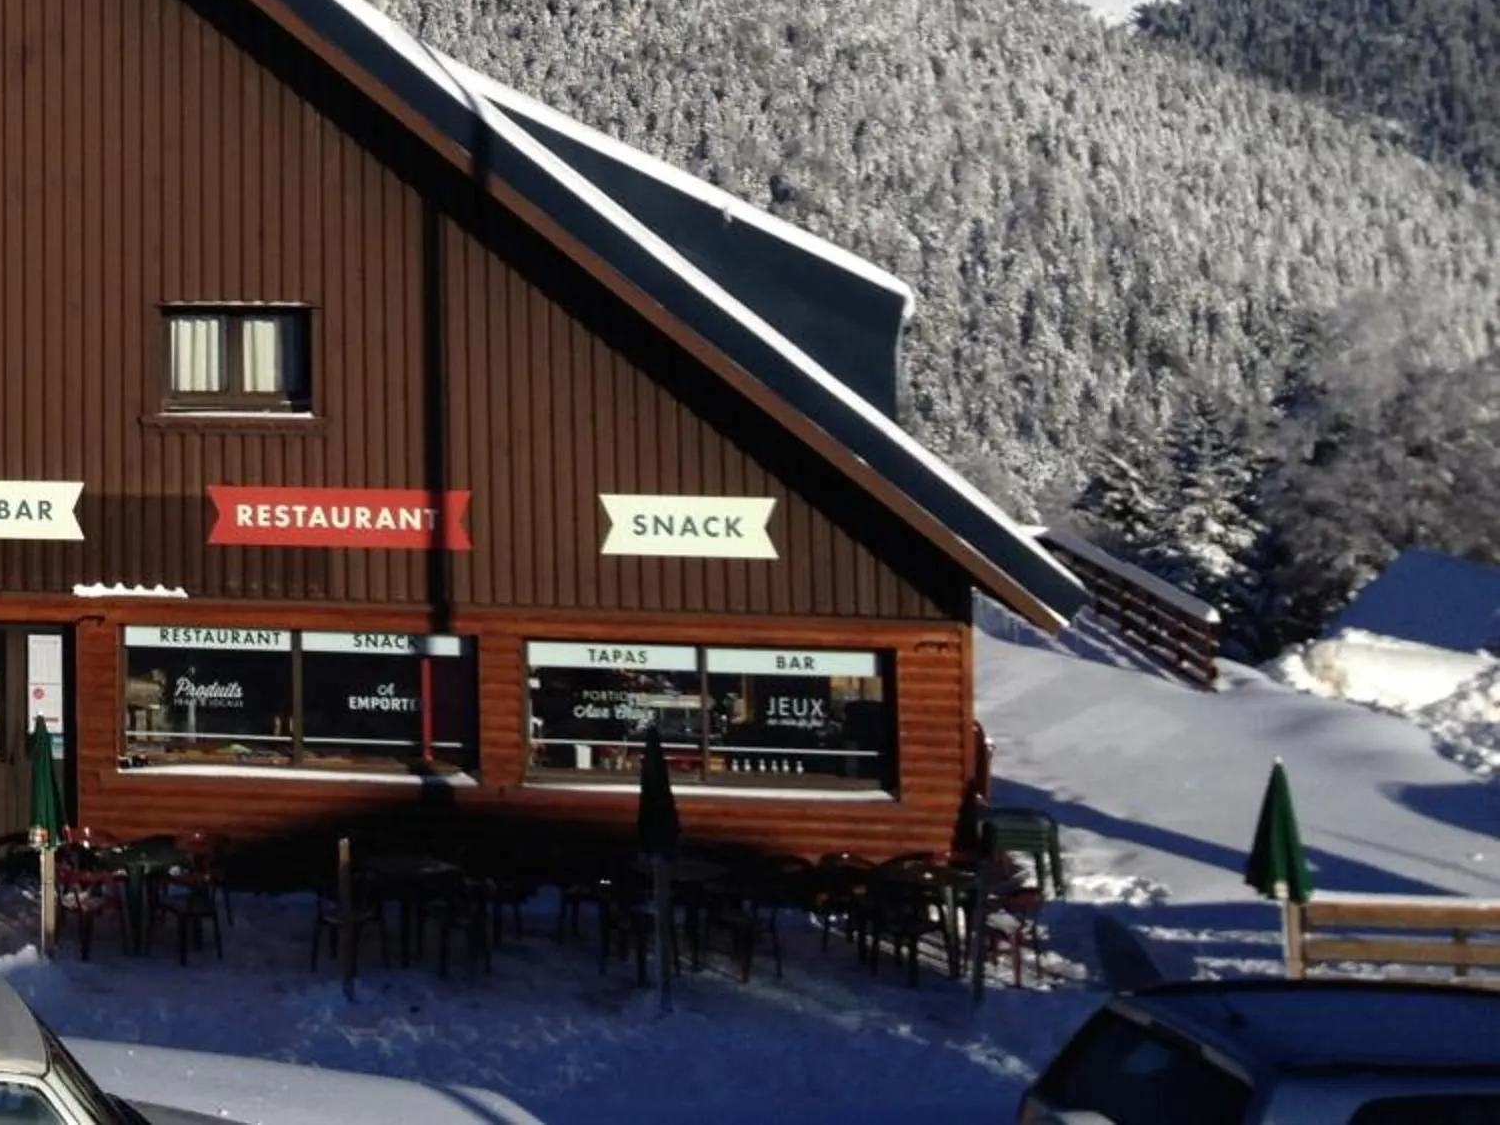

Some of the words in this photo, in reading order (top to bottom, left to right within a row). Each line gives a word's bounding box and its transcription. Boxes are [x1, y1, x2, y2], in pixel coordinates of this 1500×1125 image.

[235, 503, 440, 532] RESTAURANT
[631, 513, 744, 540] SNACK
[159, 628, 282, 646] RESTAURANT
[353, 633, 419, 650] SNACK
[588, 648, 649, 665] TAPAS
[775, 655, 816, 671] BAR
[174, 676, 244, 699] Produits
[765, 696, 825, 717] JEUX
